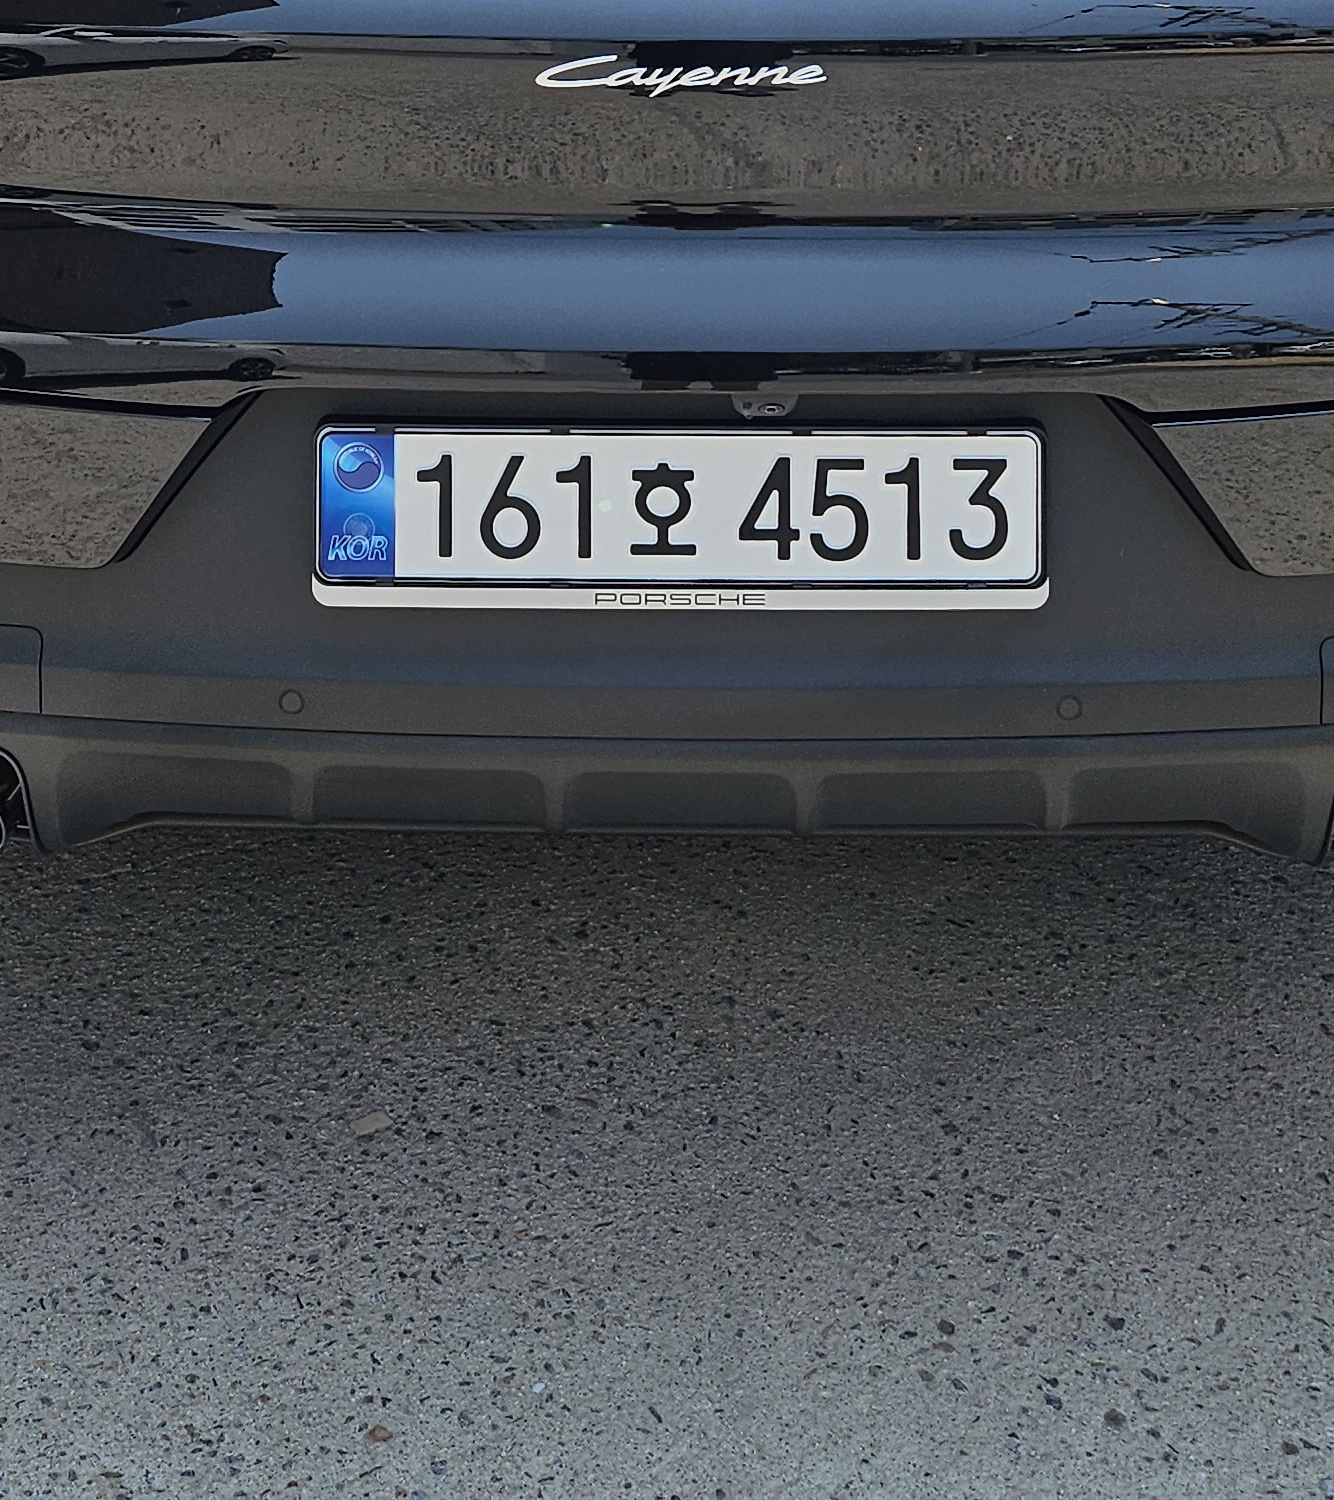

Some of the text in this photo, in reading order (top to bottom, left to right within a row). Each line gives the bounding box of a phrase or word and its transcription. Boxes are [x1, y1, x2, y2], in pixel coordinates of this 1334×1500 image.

[534, 54, 828, 98] Cayenne
[415, 453, 1010, 563] 161호 4513
[327, 535, 389, 561] KOR
[593, 592, 766, 607] PORSCHE
